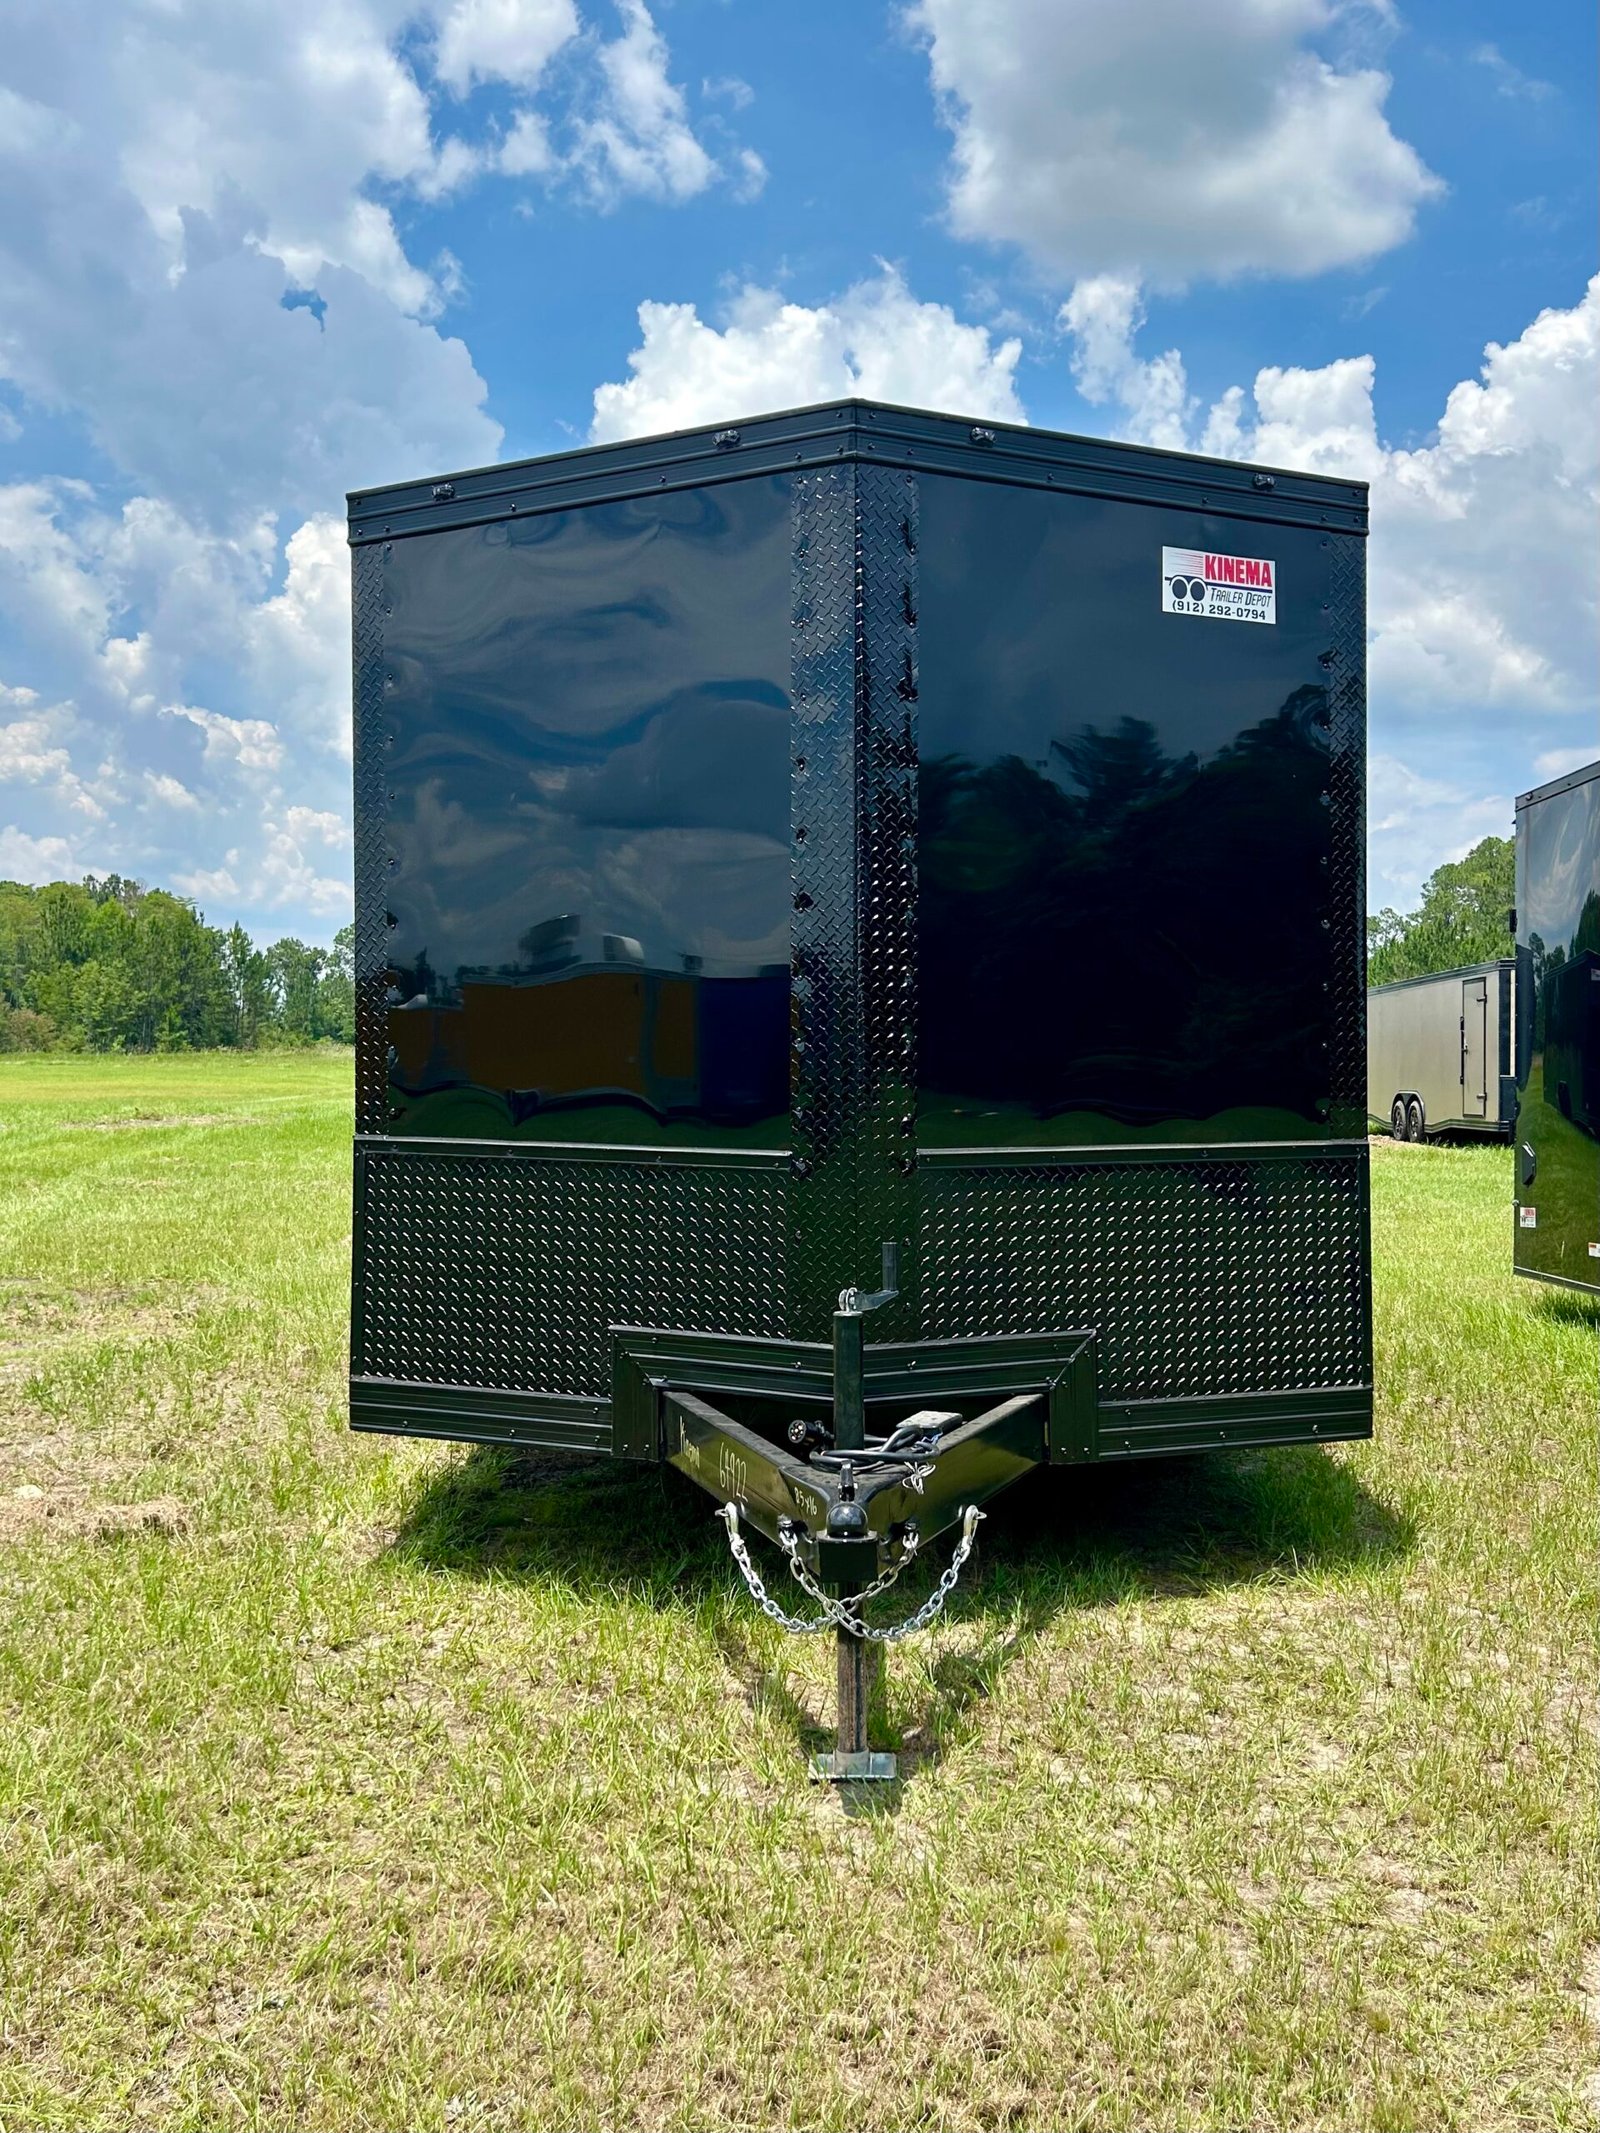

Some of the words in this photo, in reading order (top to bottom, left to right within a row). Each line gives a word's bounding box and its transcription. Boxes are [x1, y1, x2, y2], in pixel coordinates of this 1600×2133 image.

[1205, 555, 1272, 587] KINEMA
[1172, 600, 1204, 614] (912)
[1209, 605, 1266, 620] 292-0794
[1210, 588, 1243, 604] TRAILER
[1245, 592, 1272, 607] DEPOT
[719, 1442, 749, 1502] 64922
